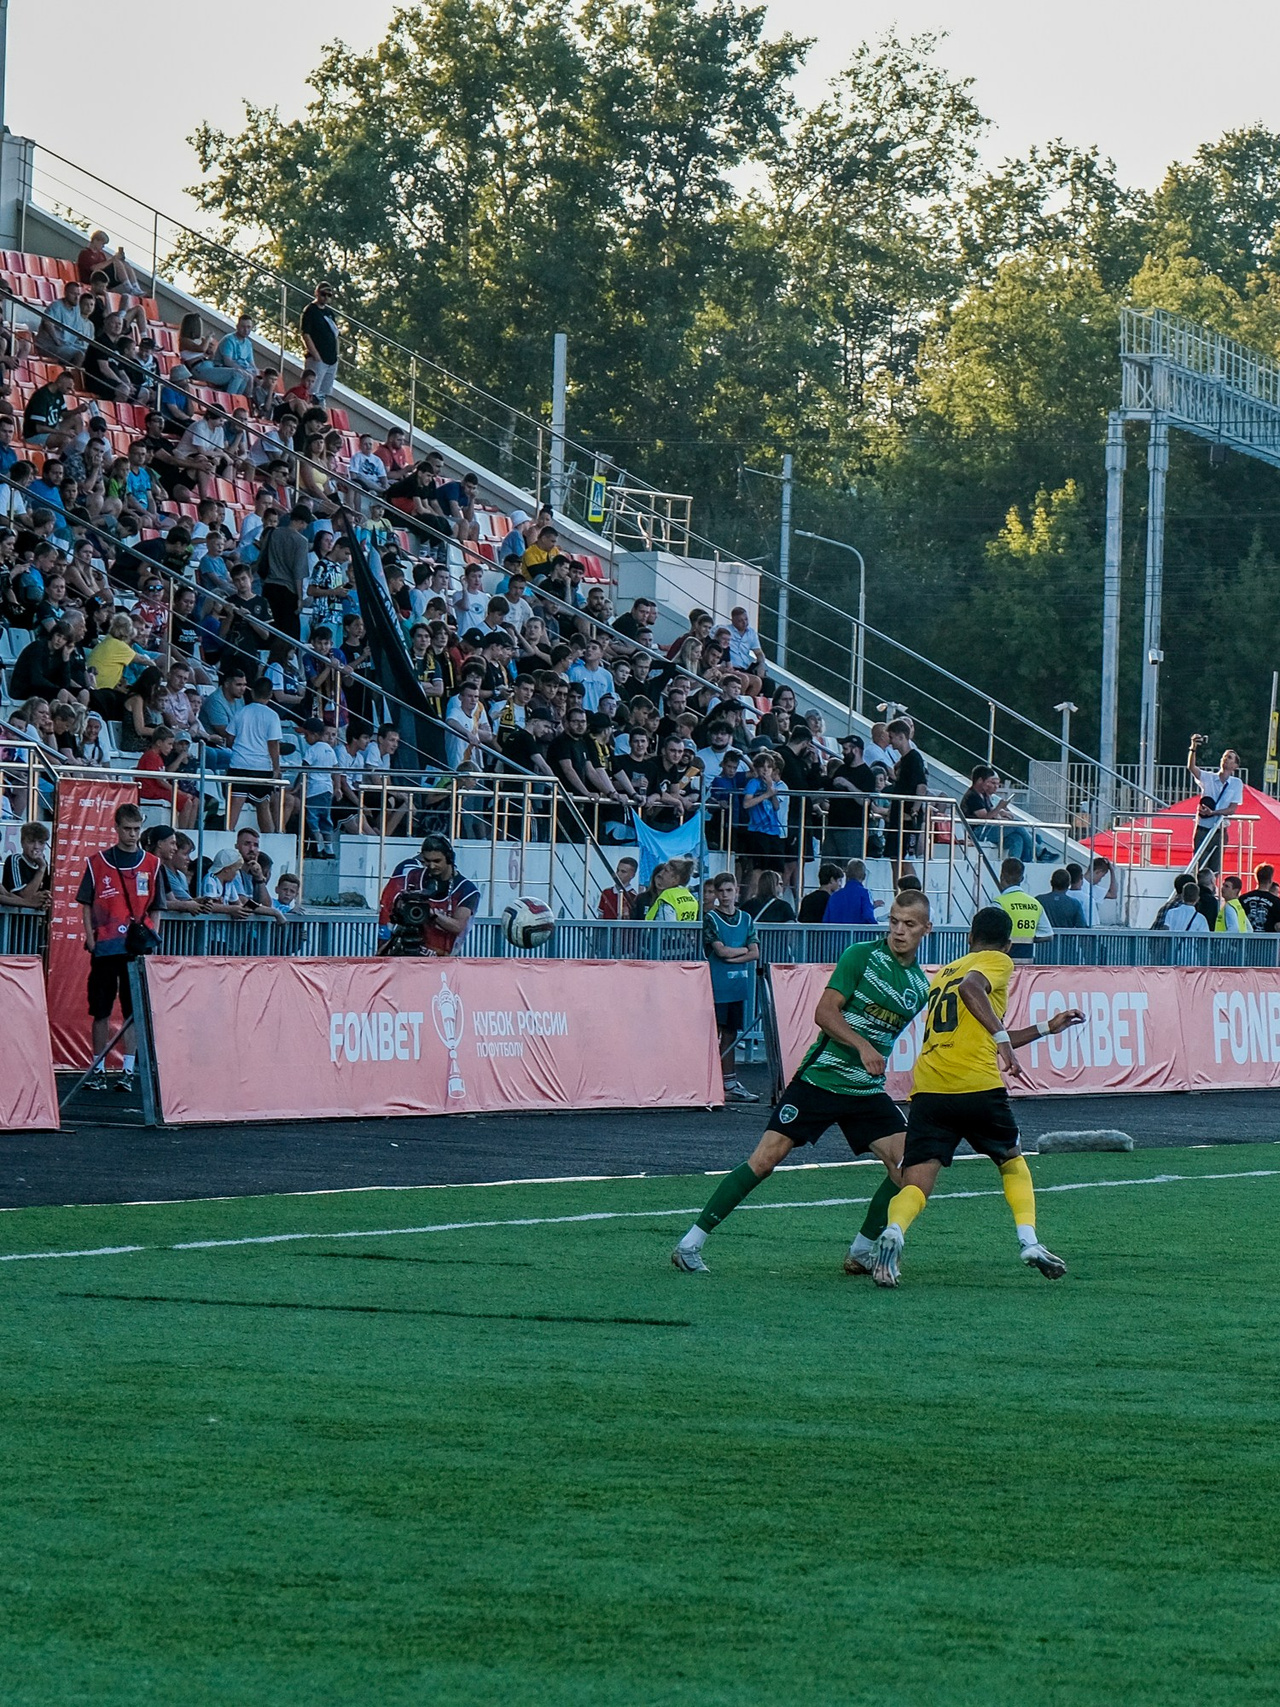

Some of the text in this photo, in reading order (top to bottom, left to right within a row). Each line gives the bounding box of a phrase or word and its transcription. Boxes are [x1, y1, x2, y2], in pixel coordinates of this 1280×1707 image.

[1010, 903, 1039, 911] STEWARD
[1017, 919, 1036, 930] 683
[330, 1011, 424, 1063] FONBET
[472, 1010, 568, 1037] КУБОК РОССИИ
[1029, 990, 1149, 1069] FONBET
